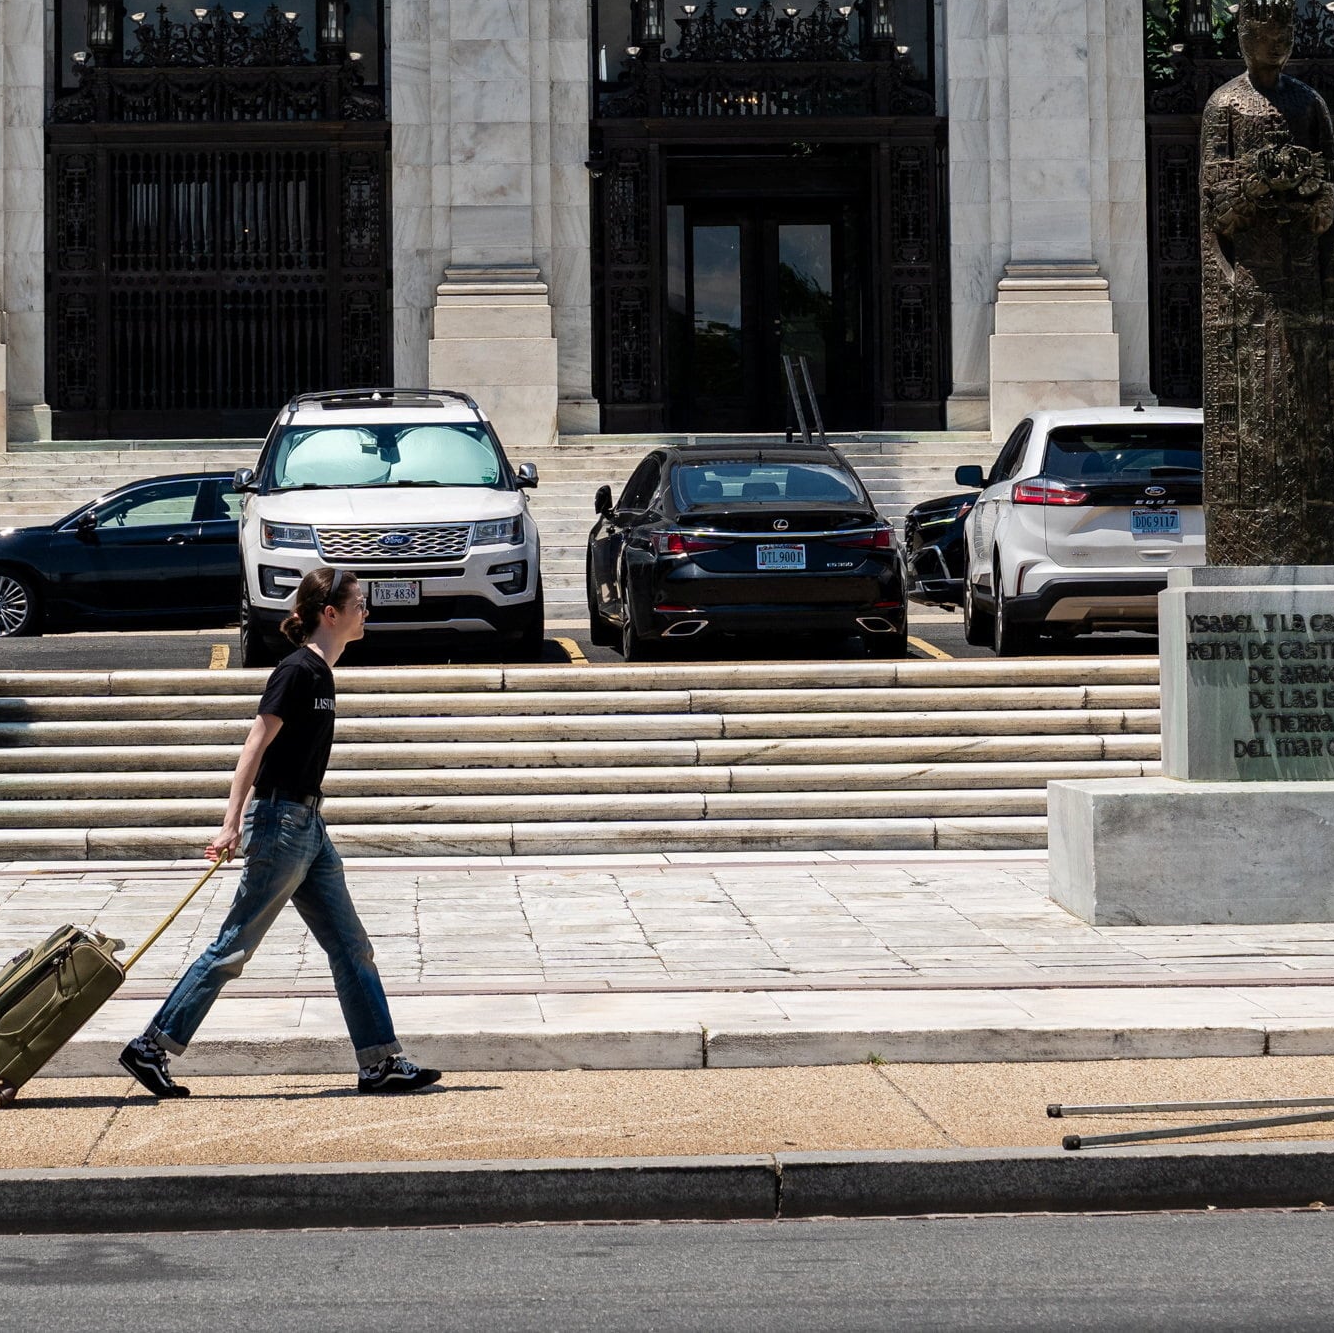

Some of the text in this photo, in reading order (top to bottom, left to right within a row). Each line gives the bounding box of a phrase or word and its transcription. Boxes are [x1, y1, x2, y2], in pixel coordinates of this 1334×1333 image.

[1136, 516, 1175, 527] DDG 9117
[762, 552, 802, 563] DTL 9001
[375, 589, 416, 599] VXB-4838
